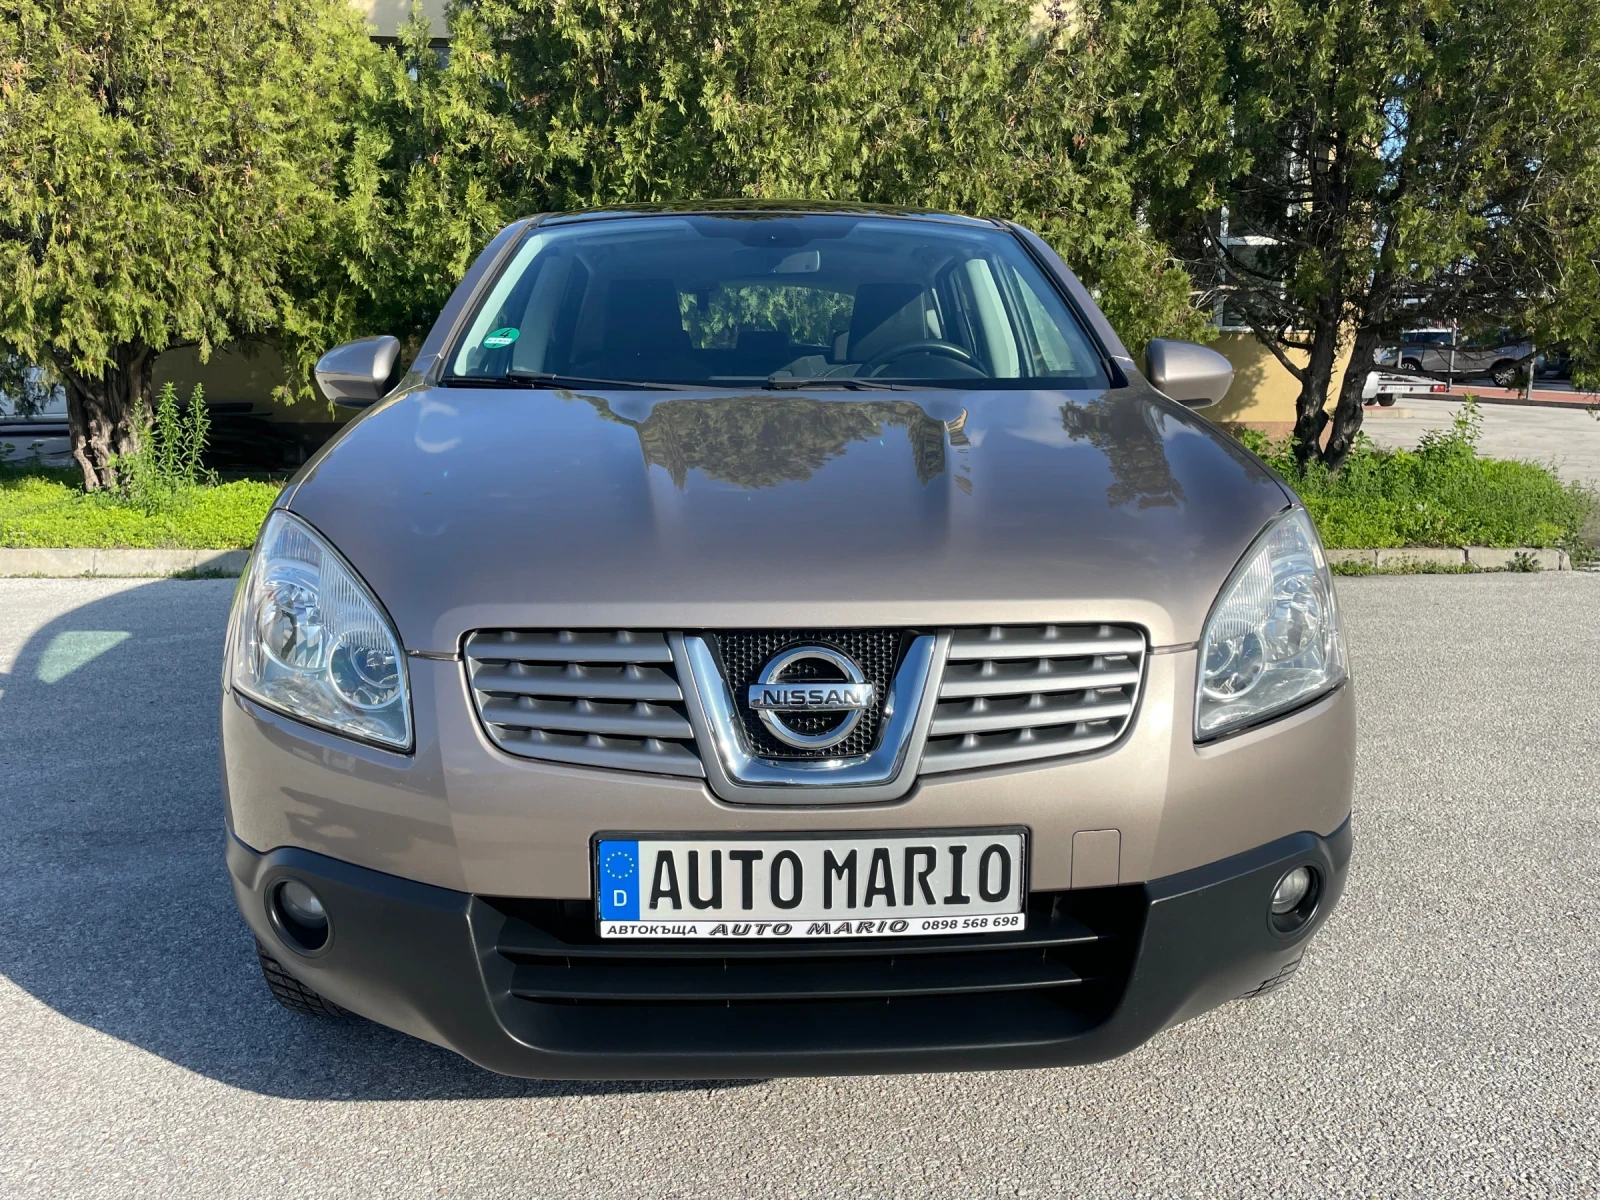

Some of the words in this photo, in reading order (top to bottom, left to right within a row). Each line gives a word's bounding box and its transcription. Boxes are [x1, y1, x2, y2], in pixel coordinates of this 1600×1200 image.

[499, 328, 512, 338] 4
[762, 689, 861, 705] NISSAN
[649, 849, 804, 910] AUTO
[823, 843, 1012, 910] MARIO
[613, 889, 628, 907] D
[607, 924, 698, 936] АВТОКЪЩА
[709, 922, 794, 936] AUTO
[806, 919, 910, 935] MARIO
[921, 919, 958, 931] 0898
[962, 917, 989, 929] 568
[992, 916, 1019, 927] 698
